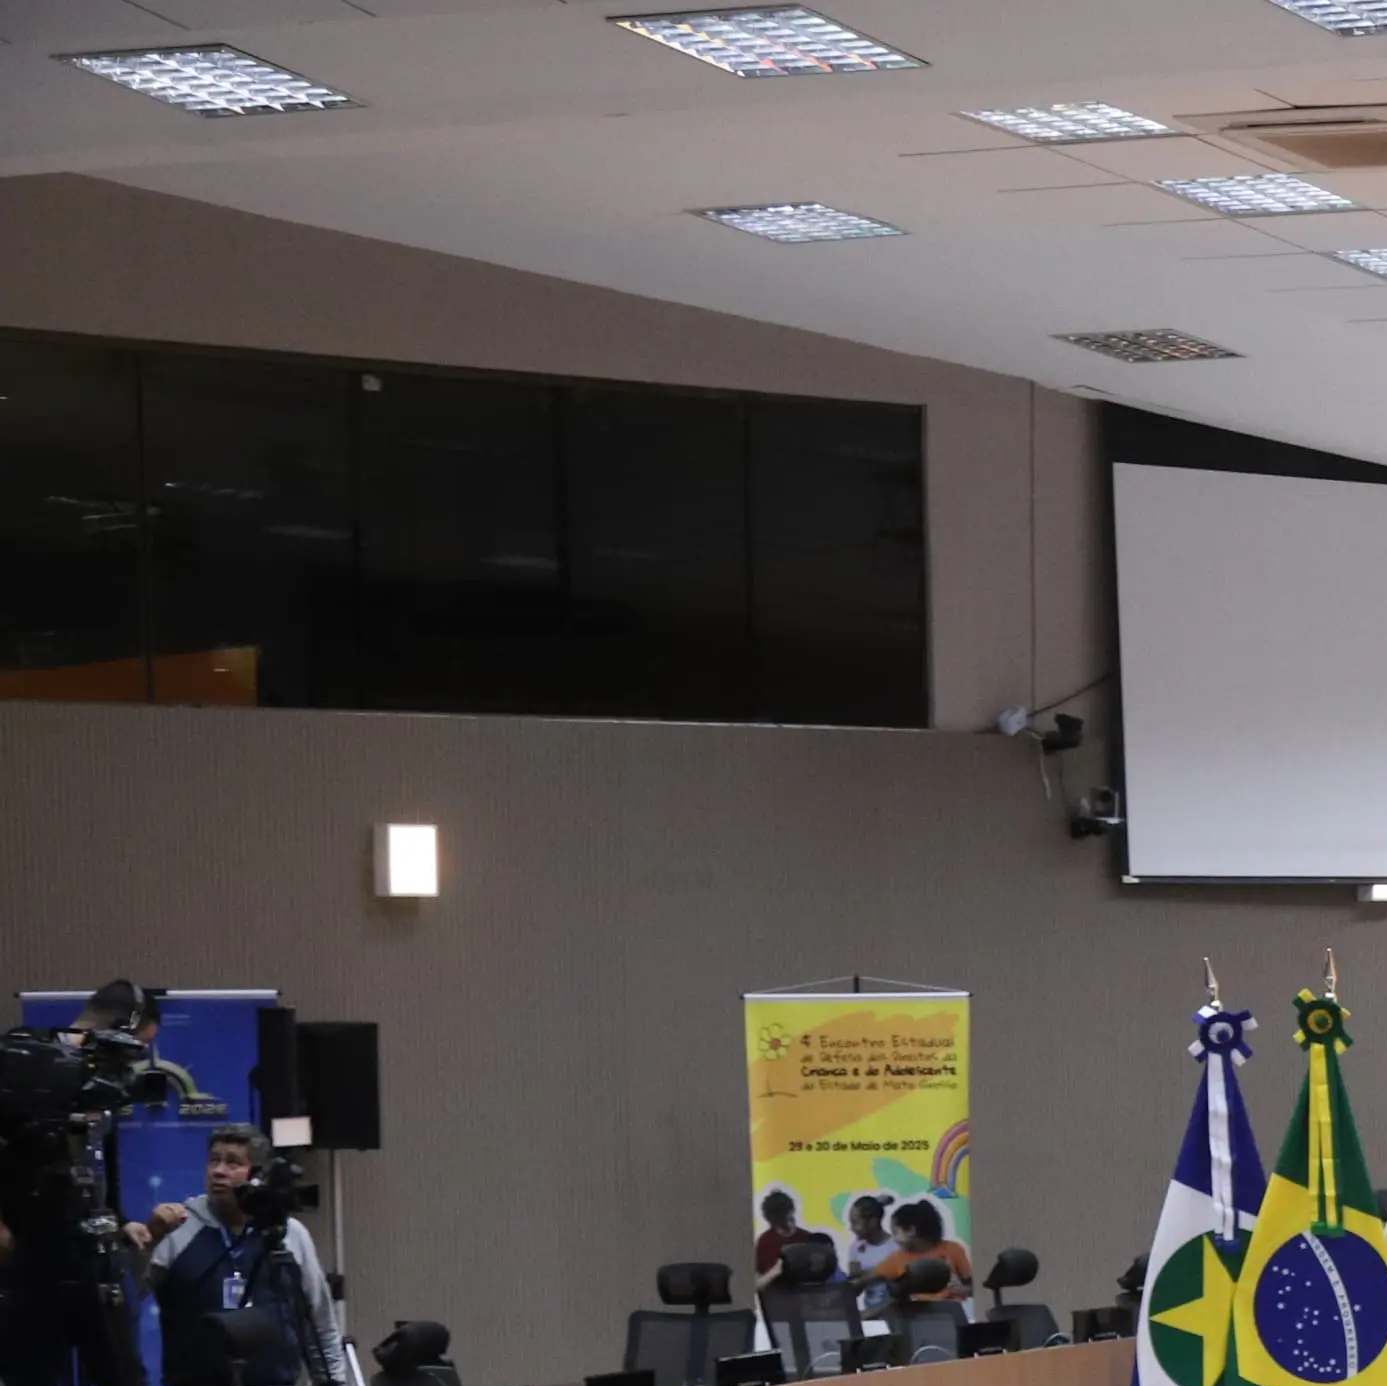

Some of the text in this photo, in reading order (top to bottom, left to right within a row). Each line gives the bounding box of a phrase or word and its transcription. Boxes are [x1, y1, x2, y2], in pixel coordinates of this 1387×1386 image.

[832, 1140, 848, 1152] de
[850, 1140, 881, 1152] Maio
[883, 1140, 899, 1151] de
